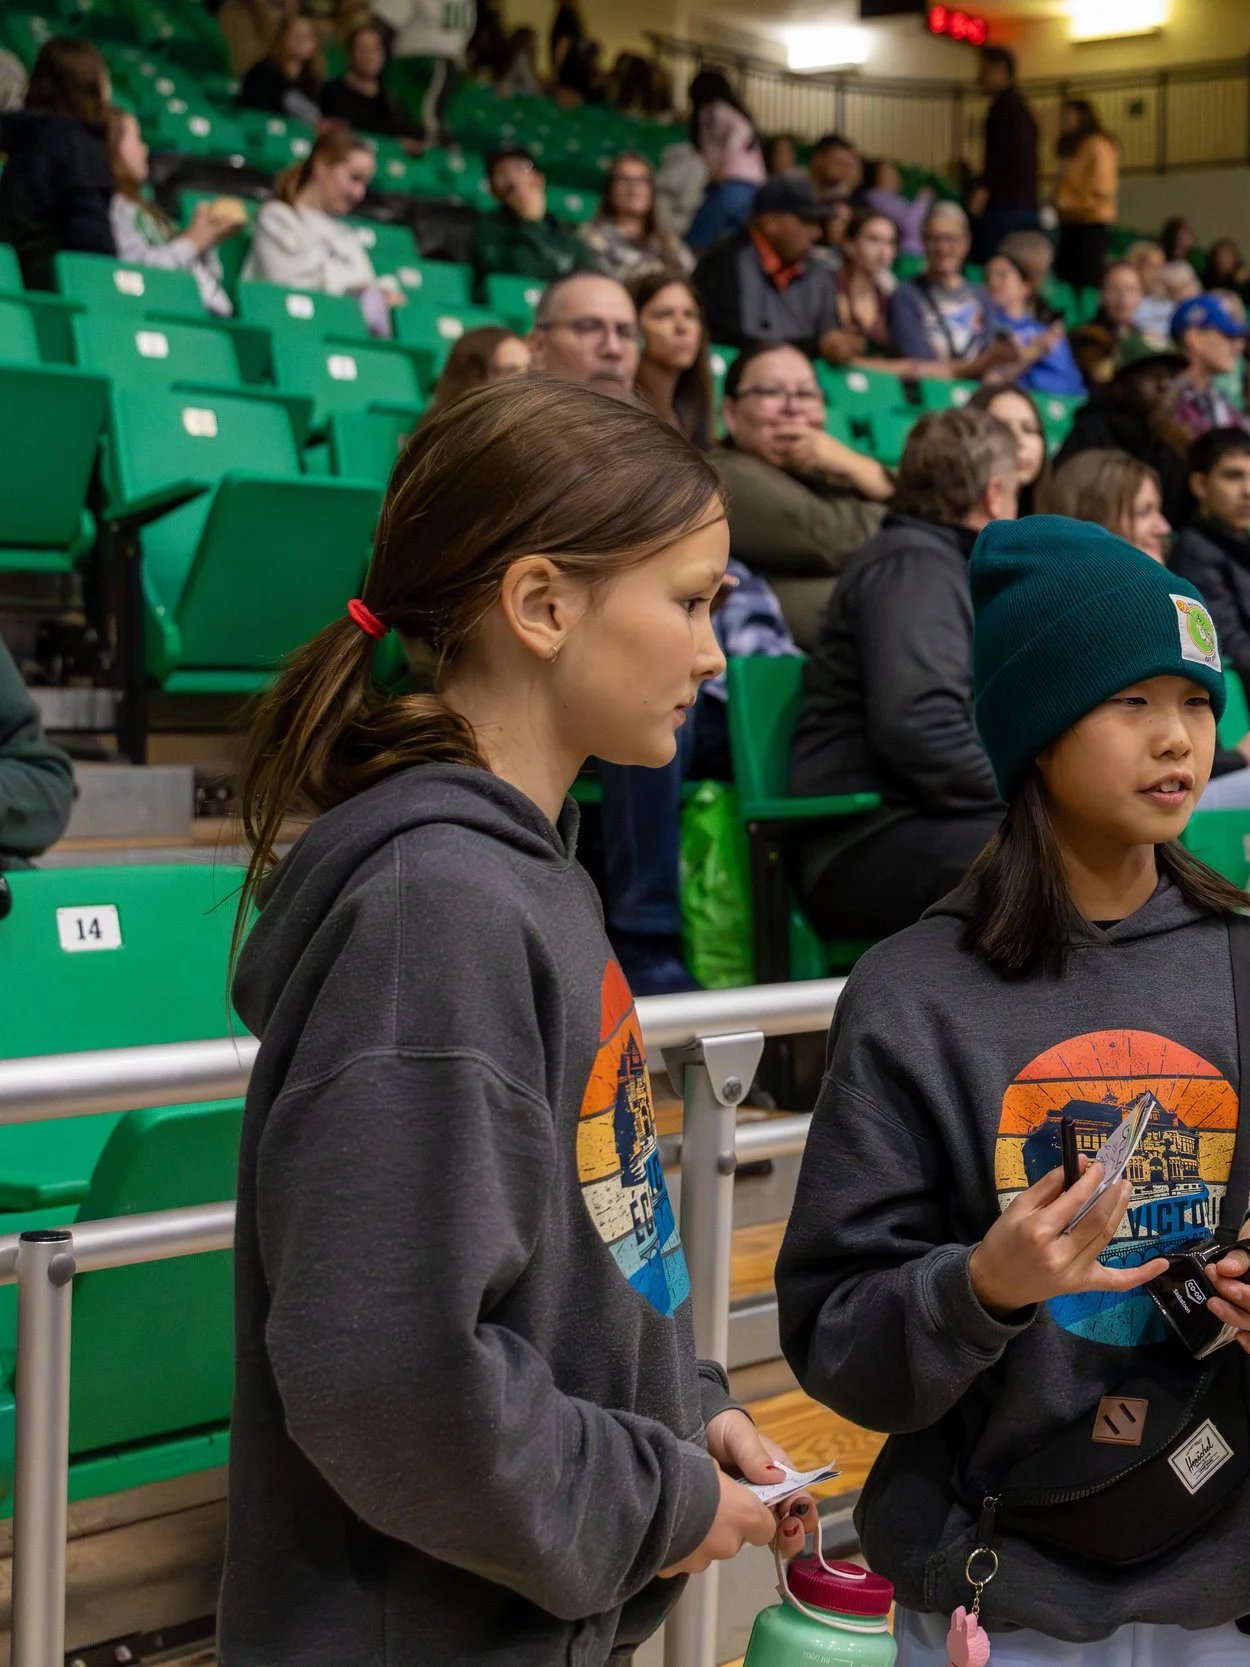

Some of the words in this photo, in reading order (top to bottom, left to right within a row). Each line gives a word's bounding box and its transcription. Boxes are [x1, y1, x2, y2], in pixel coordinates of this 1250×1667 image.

[76, 917, 103, 941] 14
[1172, 1288, 1191, 1314] Saskatoon
[1184, 1436, 1214, 1474] Herschel
